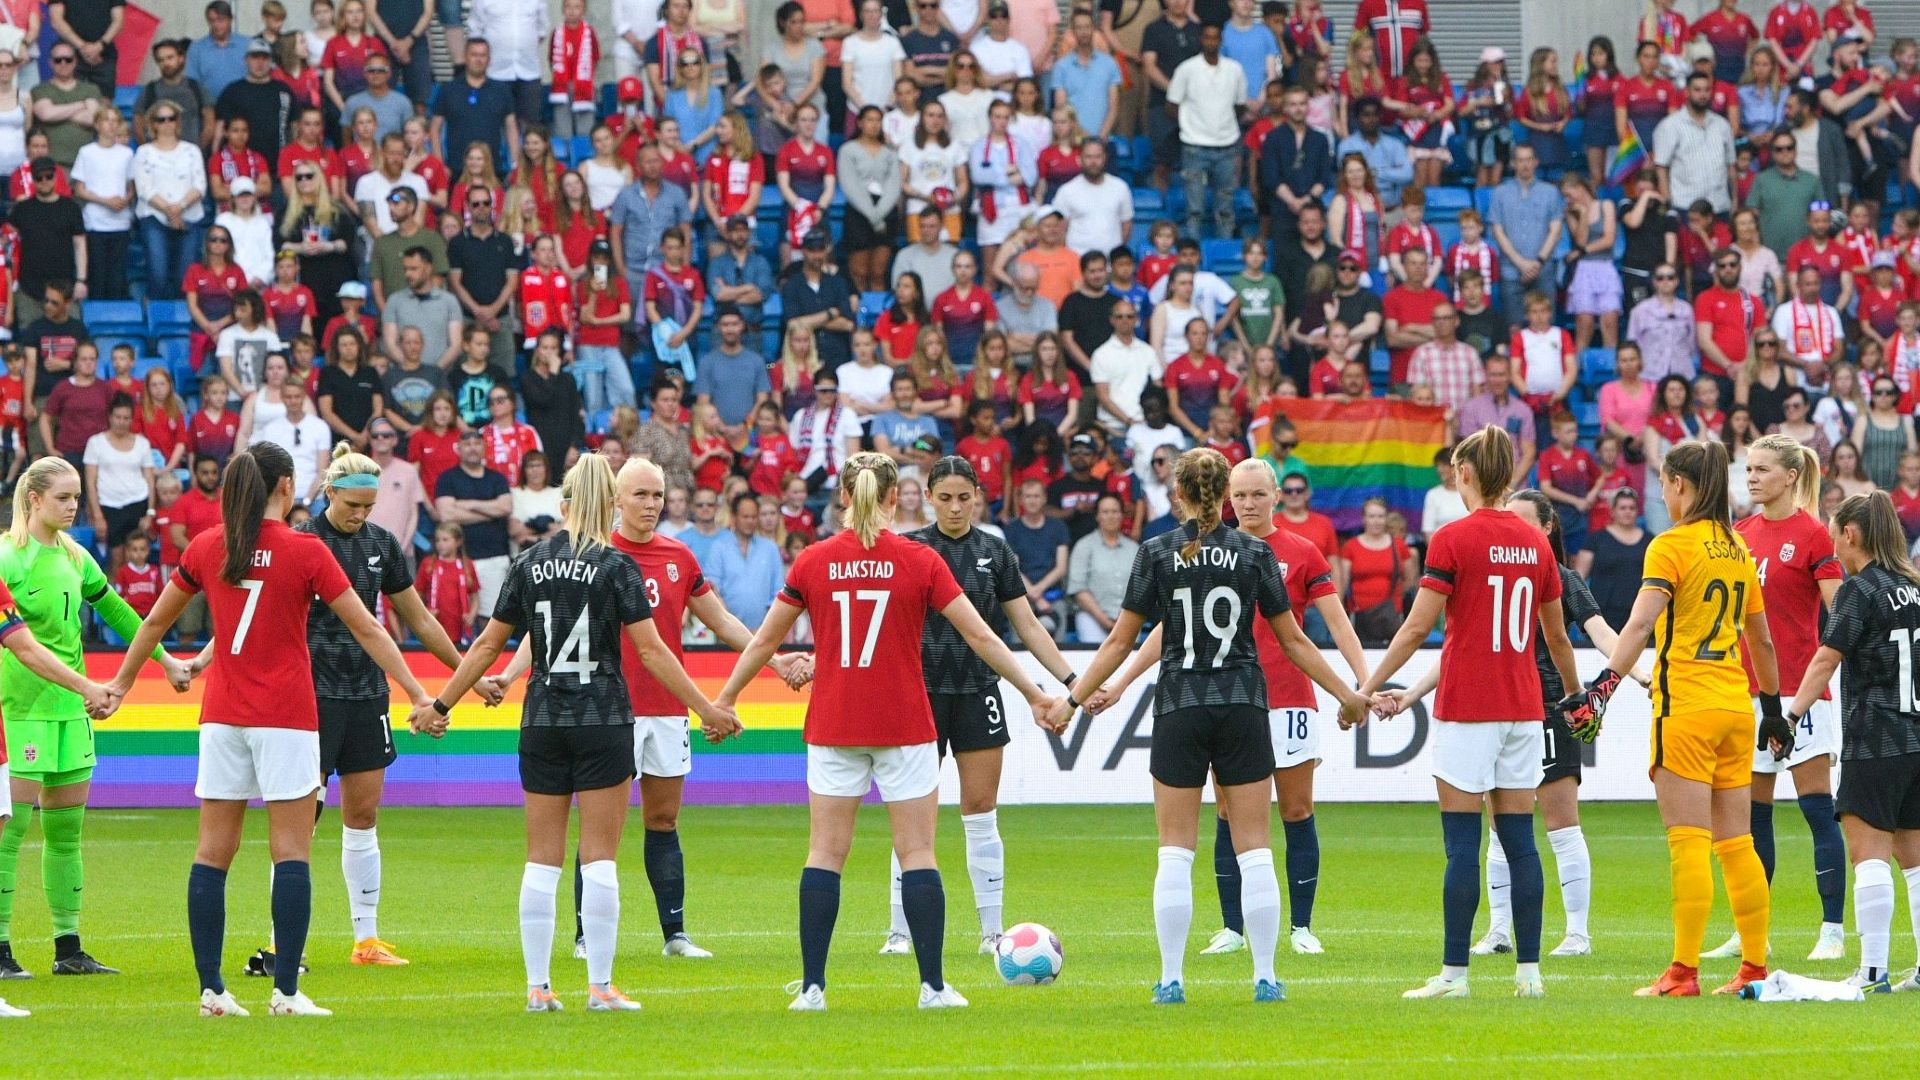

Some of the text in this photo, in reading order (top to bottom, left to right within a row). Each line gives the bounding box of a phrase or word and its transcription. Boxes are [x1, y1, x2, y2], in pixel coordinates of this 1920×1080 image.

[250, 549, 272, 567] EN
[1173, 546, 1239, 572] ANTON
[1489, 545, 1538, 565] GRAHAM
[1703, 540, 1746, 564] ESSON
[532, 558, 598, 585] BOWEN
[829, 560, 894, 580] BLAKSTAD
[1752, 557, 1769, 587] 4
[63, 591, 70, 621] 1
[645, 577, 660, 608] 3
[231, 579, 264, 655] 7
[832, 589, 891, 668] 17
[1172, 585, 1242, 669] 19
[1487, 575, 1534, 653] 10
[1694, 578, 1746, 661] 21
[534, 600, 600, 686] 14
[985, 695, 1001, 724] 3
[1286, 710, 1308, 740] 18
